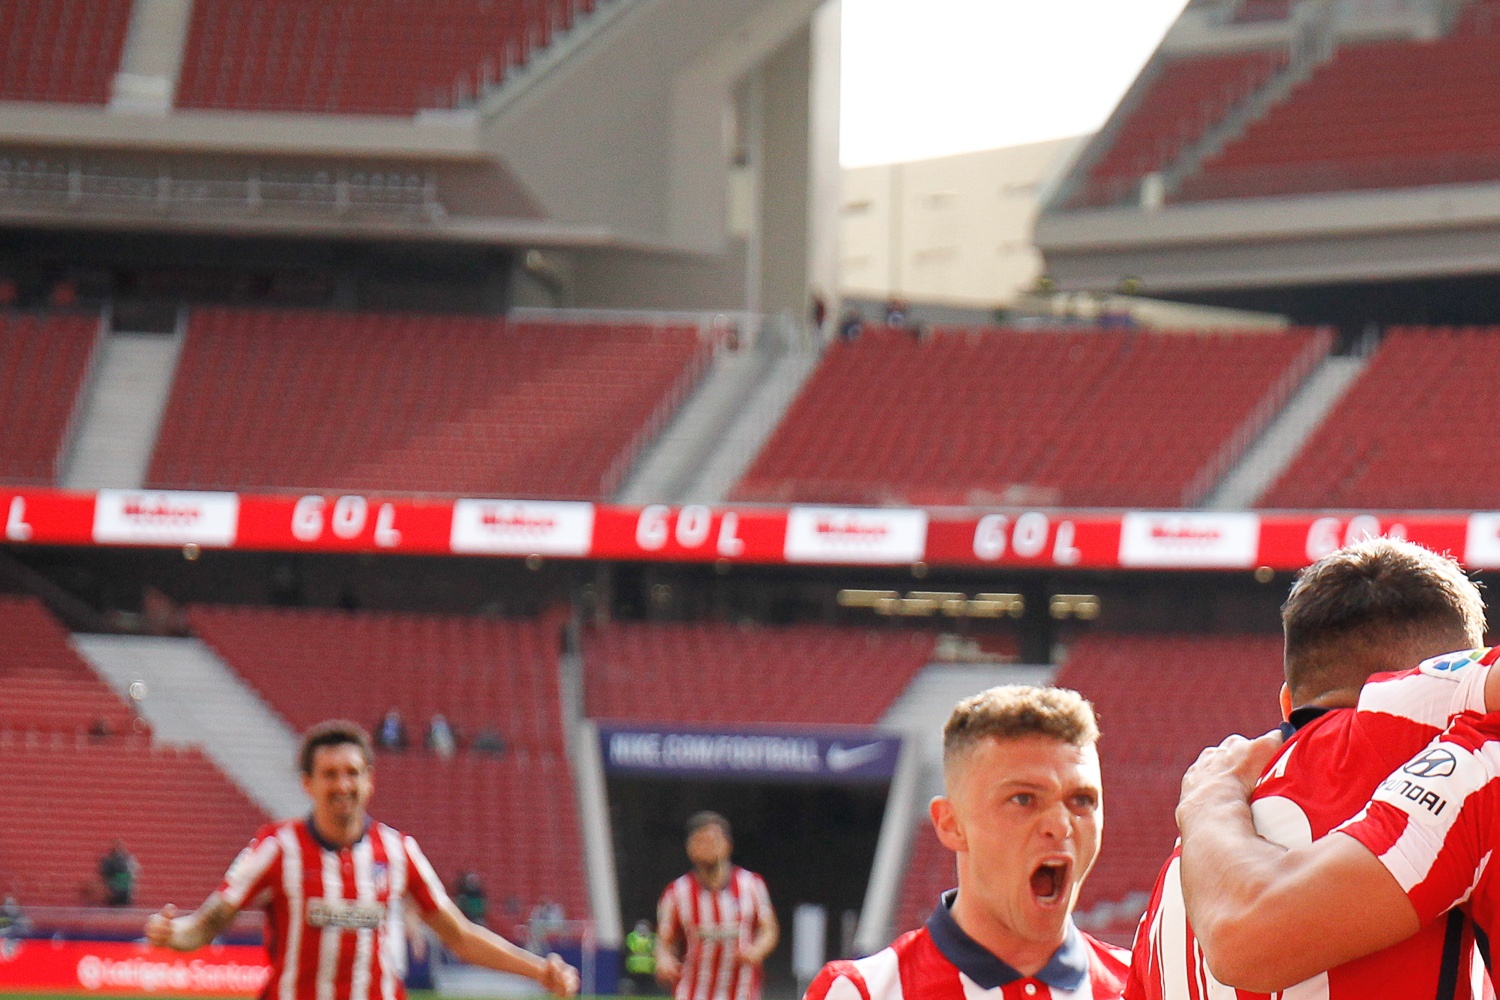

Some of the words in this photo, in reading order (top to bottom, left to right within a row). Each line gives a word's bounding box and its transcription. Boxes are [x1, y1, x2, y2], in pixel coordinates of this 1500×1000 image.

[291, 495, 401, 547] GOL
[636, 504, 744, 556] GOL
[972, 511, 1080, 564] GOL
[1306, 515, 1407, 561] GO
